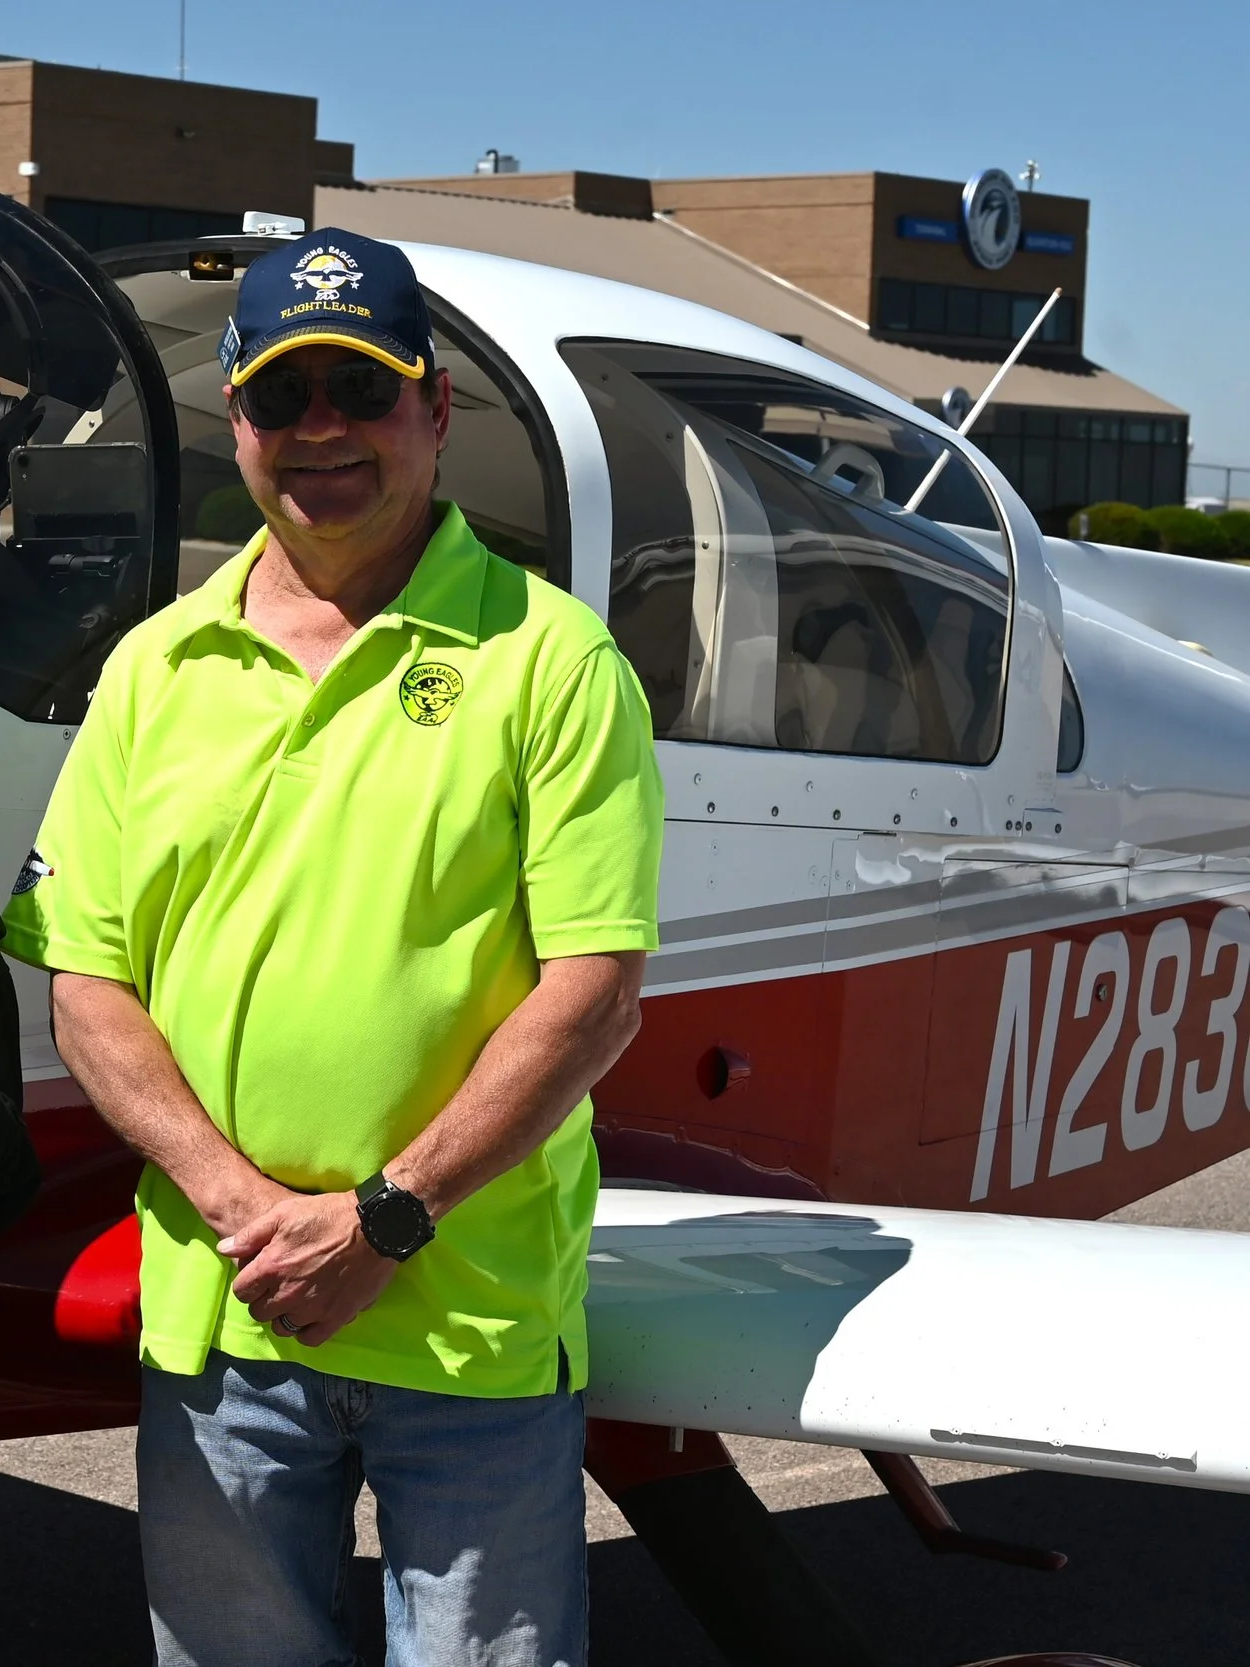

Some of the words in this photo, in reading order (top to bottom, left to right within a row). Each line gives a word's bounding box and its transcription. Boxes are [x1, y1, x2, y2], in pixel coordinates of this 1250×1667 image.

[295, 247, 324, 269] YOUNG
[328, 245, 358, 269] EAGLES
[280, 301, 322, 319] FLIGHT
[323, 301, 372, 319] LEADER
[408, 667, 435, 682] YOUNG
[436, 667, 460, 688] EAGLES
[969, 904, 1250, 1203] N283
